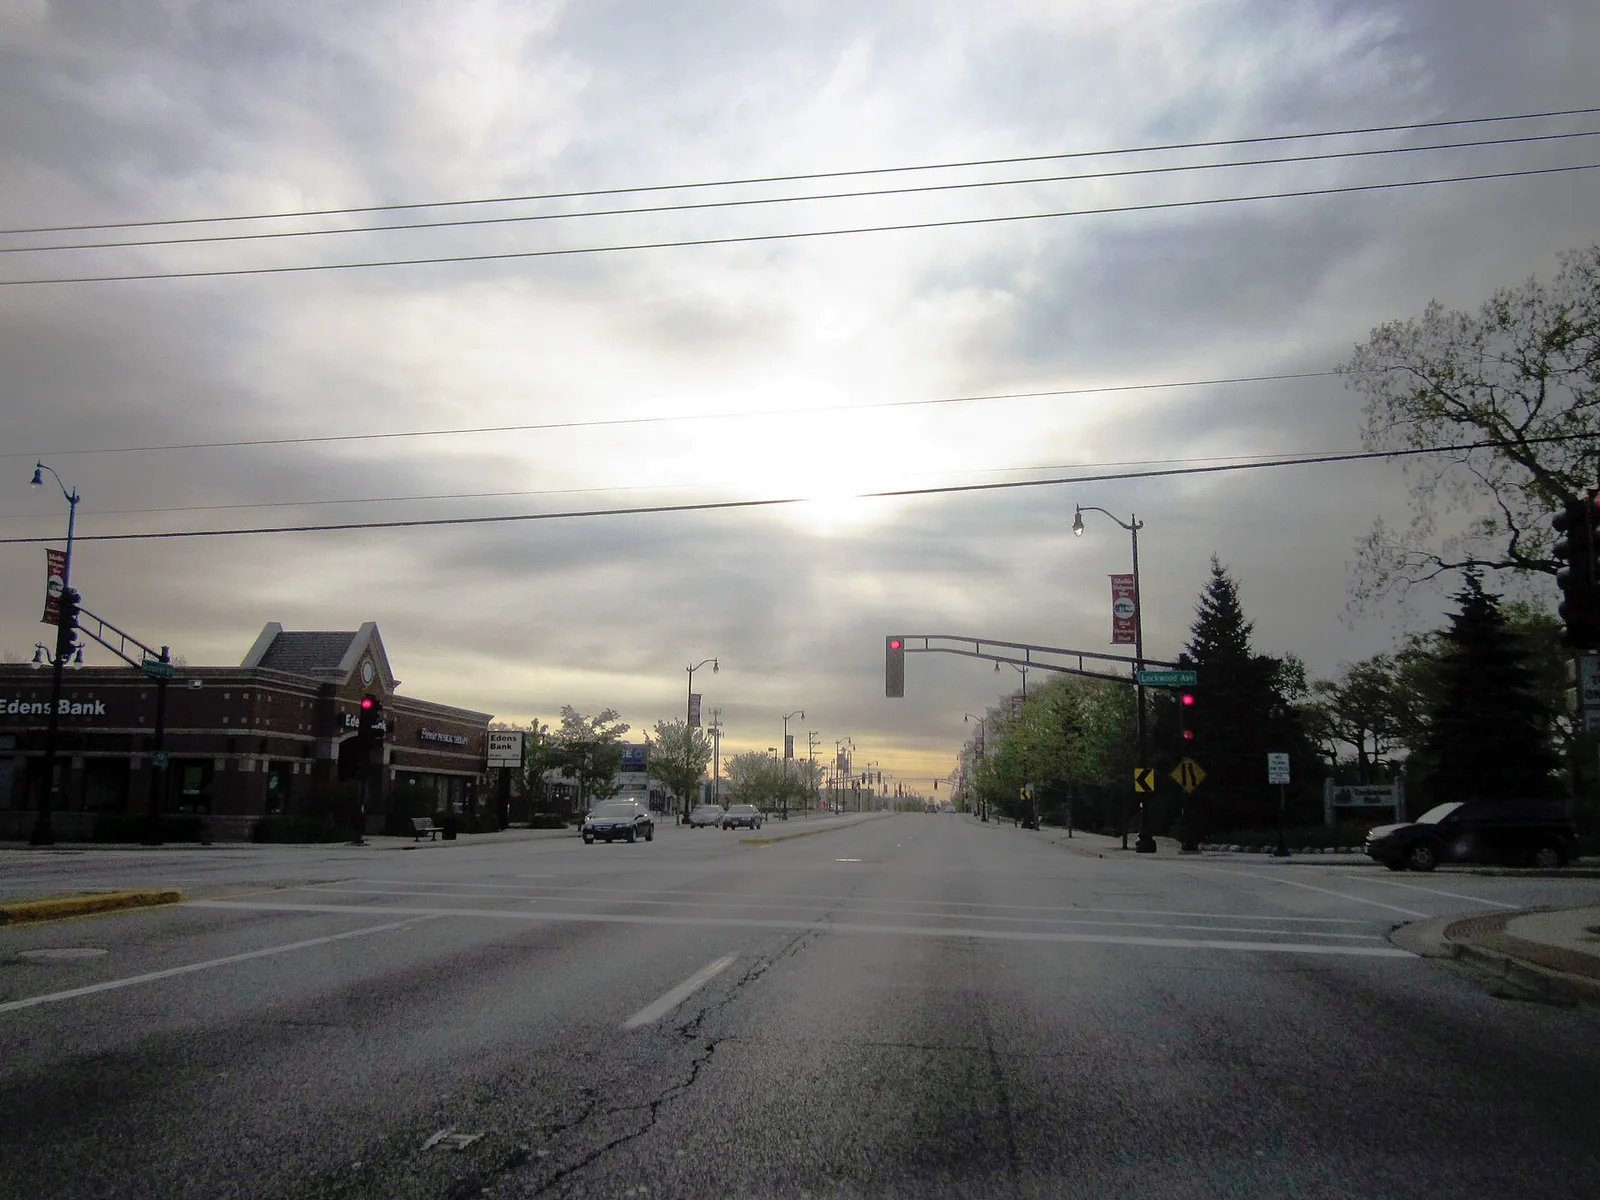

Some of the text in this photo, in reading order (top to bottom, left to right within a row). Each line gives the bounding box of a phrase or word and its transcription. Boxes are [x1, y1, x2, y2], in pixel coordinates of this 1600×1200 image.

[1141, 673, 1195, 682] Lockwood Ave
[0, 699, 106, 715] Edens Bank
[490, 734, 517, 742] Edens
